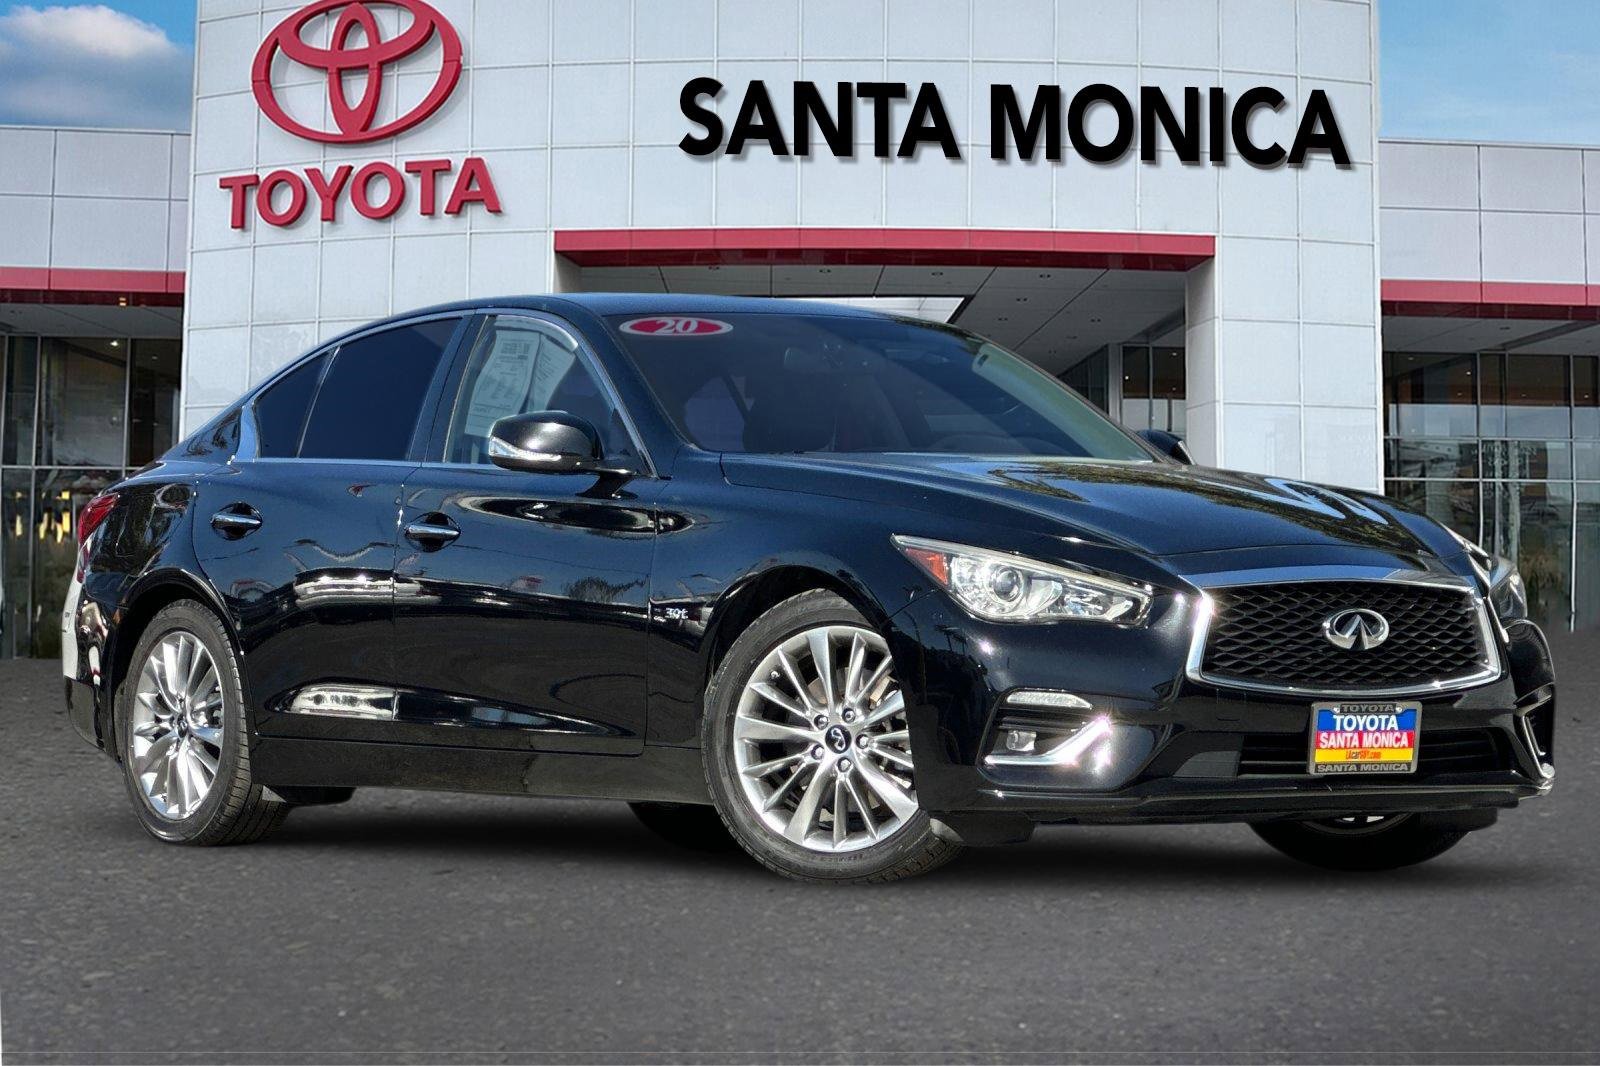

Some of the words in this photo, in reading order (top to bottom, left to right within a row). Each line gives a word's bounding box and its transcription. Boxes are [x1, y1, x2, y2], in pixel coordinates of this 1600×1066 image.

[678, 77, 960, 158] SANTA
[990, 83, 1351, 166] MONICA
[219, 157, 502, 229] TOYOTA
[655, 318, 698, 335] 20
[1341, 704, 1395, 713] TOYOTA
[1333, 714, 1398, 731] TOYOTA
[1319, 731, 1360, 749] SANTA
[1362, 731, 1409, 749] MONICA
[1317, 763, 1359, 773] SANTA
[1360, 763, 1409, 773] MONICA
